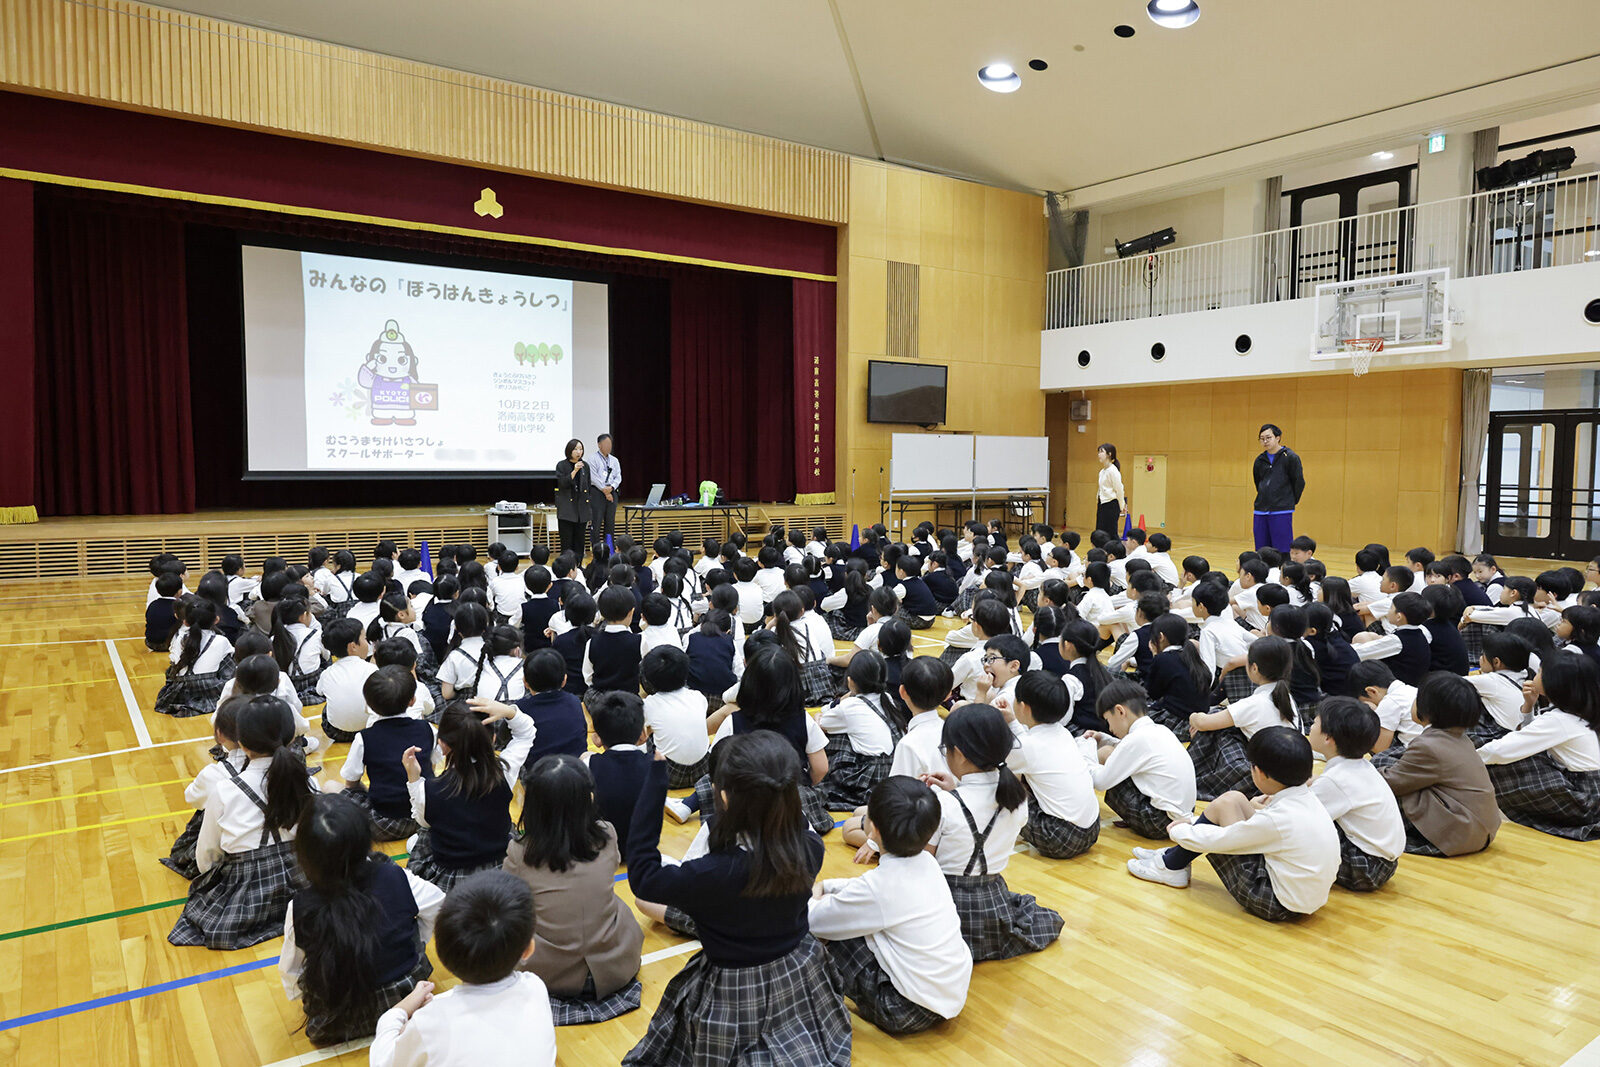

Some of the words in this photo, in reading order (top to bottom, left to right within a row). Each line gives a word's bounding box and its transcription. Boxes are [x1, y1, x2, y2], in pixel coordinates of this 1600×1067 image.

[498, 399, 550, 410] 10月22日
[497, 411, 555, 422] 洛南高等学校
[325, 435, 444, 447] むこうまちけいさつしょ
[327, 448, 424, 459] スクールサポーター
